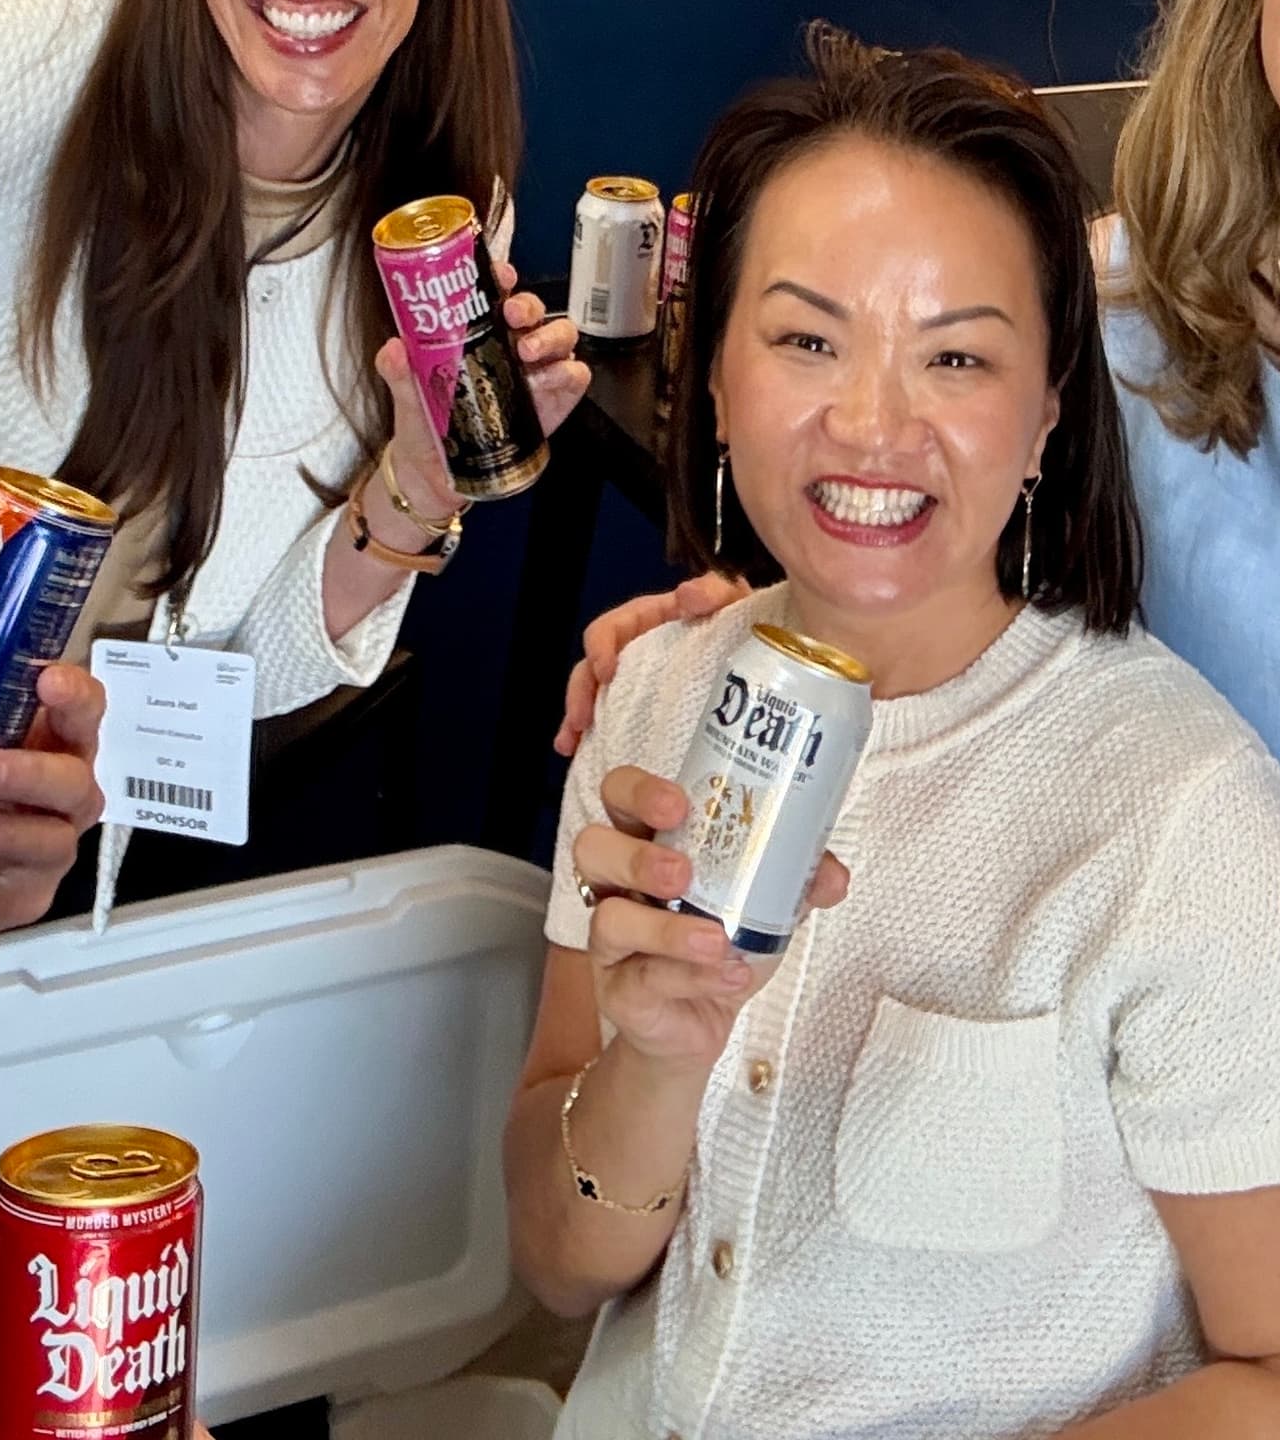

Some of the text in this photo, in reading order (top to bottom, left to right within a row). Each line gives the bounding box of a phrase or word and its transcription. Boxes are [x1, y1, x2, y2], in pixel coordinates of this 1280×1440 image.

[392, 255, 479, 308] Liquid
[408, 286, 490, 335] Death
[712, 668, 823, 768] Death
[755, 682, 798, 718] Liquid
[135, 809, 208, 832] SPONSOR
[65, 1202, 172, 1231] MURDER MYSTERY
[27, 1238, 189, 1348] Liquid
[36, 1308, 186, 1402] Death
